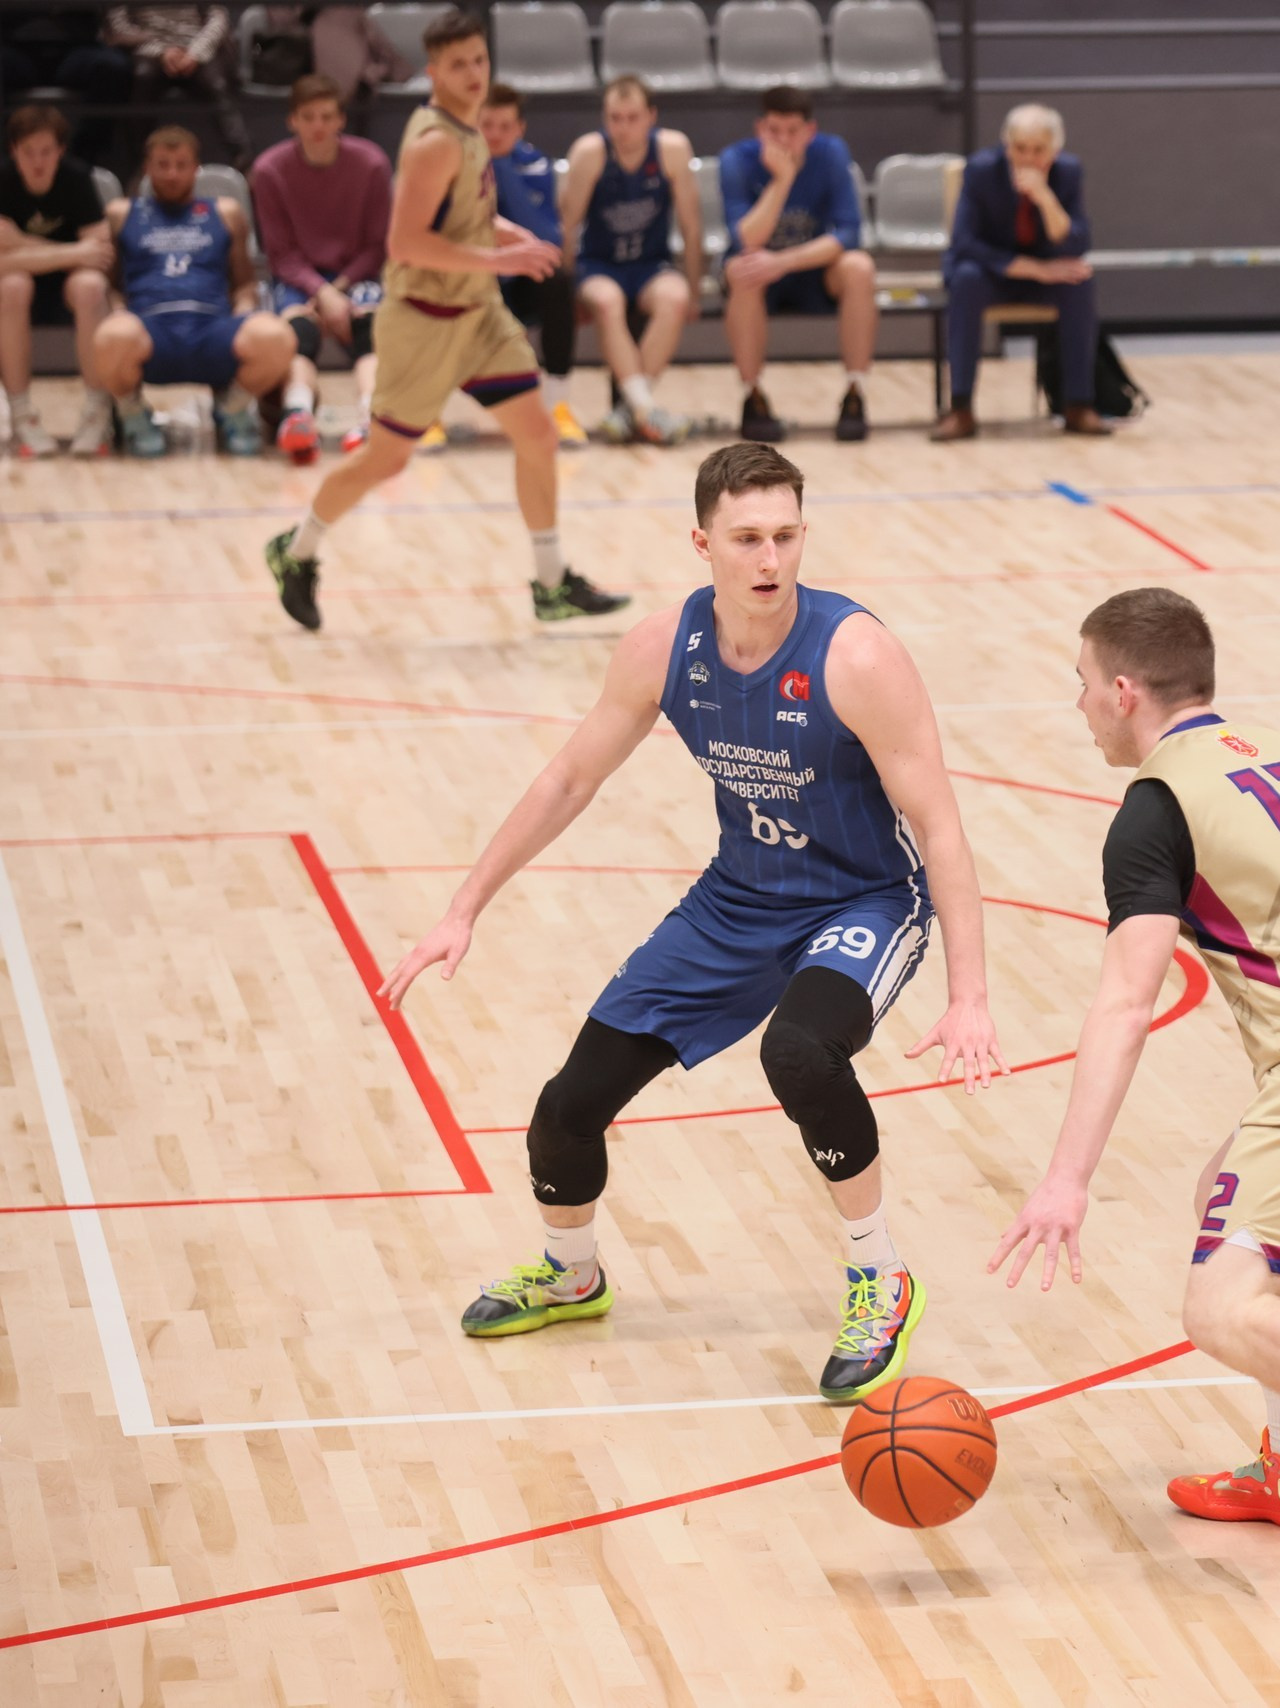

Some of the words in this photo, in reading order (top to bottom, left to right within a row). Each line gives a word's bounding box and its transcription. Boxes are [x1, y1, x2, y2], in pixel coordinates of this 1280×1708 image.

[709, 740, 791, 768] МОСКОВСКИЙ
[718, 777, 799, 802] ИВЕРСИТЕТ
[807, 925, 877, 959] 69
